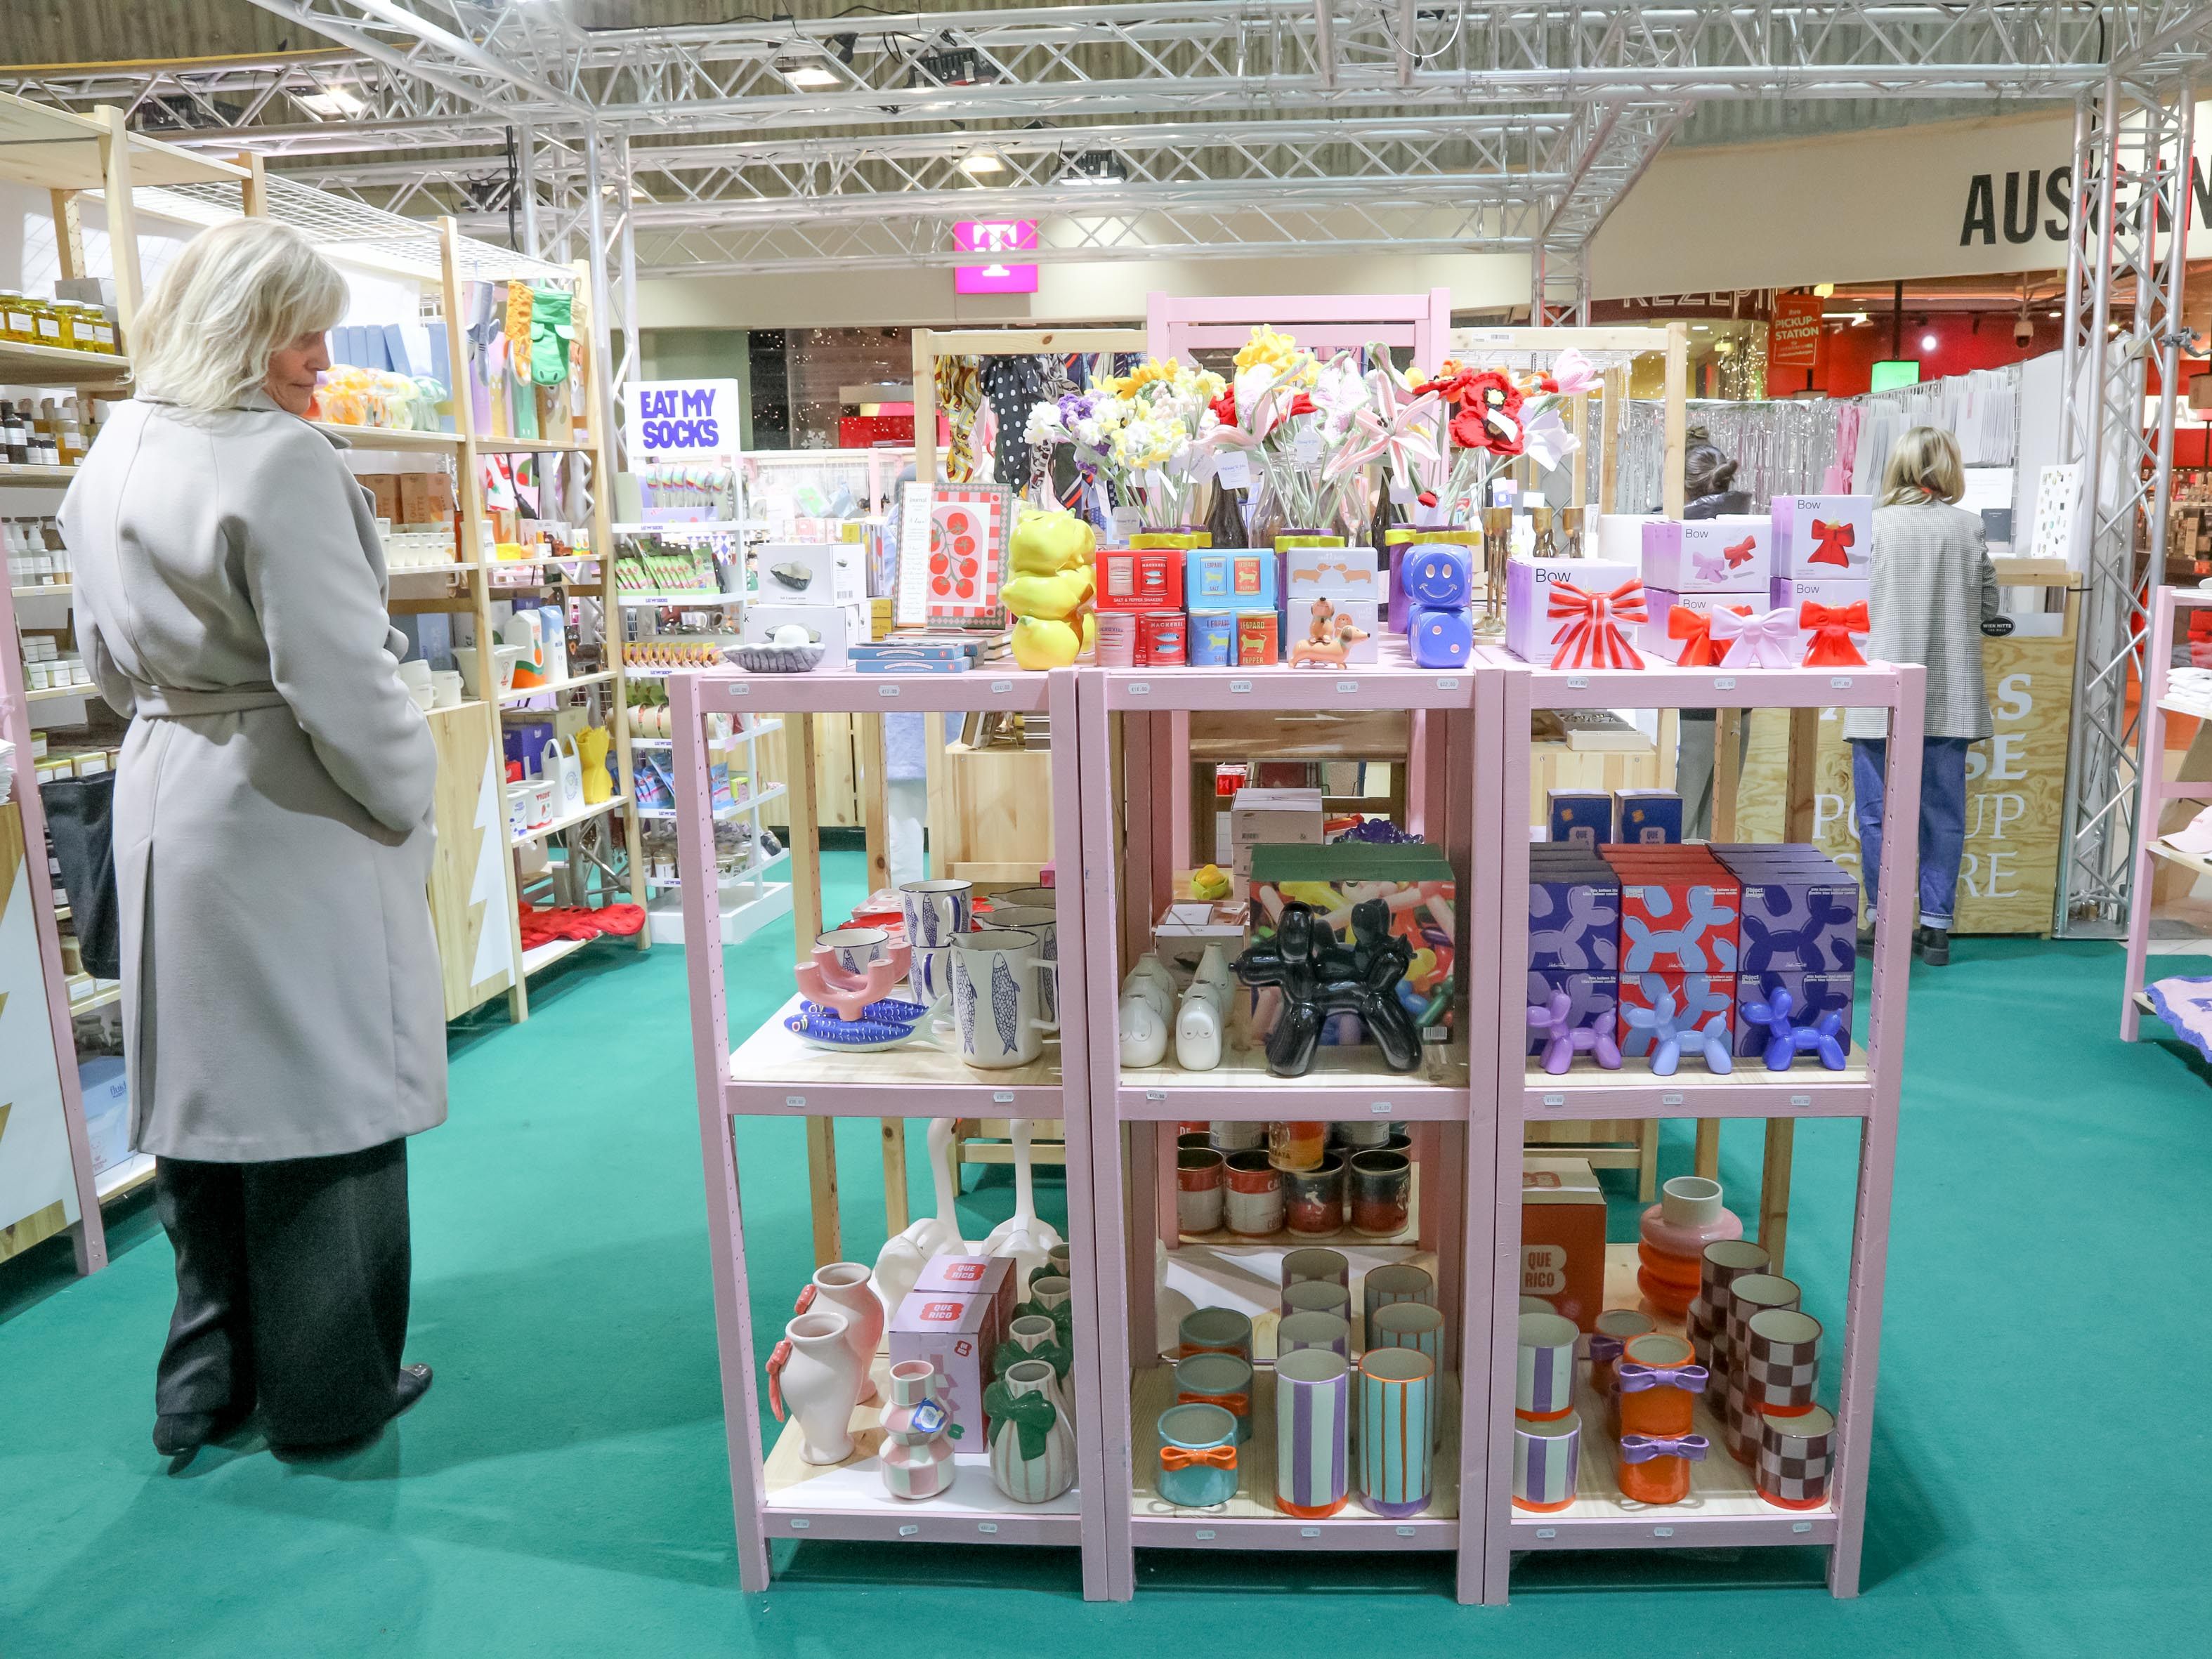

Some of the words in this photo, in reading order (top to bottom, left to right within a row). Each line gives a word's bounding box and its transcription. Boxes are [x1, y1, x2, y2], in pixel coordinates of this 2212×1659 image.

[1775, 326, 1819, 341] STATION
[640, 390, 679, 419] EAT
[681, 388, 716, 417] MY
[642, 419, 719, 450] SOCKS
[1797, 499, 1821, 510] Bow
[1685, 528, 1708, 539] Bow
[1535, 568, 1571, 582] Bow
[1796, 584, 1820, 595] Bow
[1682, 599, 1706, 609] Bow
[1241, 621, 1264, 629] LEOPARD
[1576, 830, 1588, 839] QUE
[1647, 831, 1658, 839] QUE
[1528, 1252, 1552, 1269] QUE
[1525, 1272, 1555, 1287] RICO
